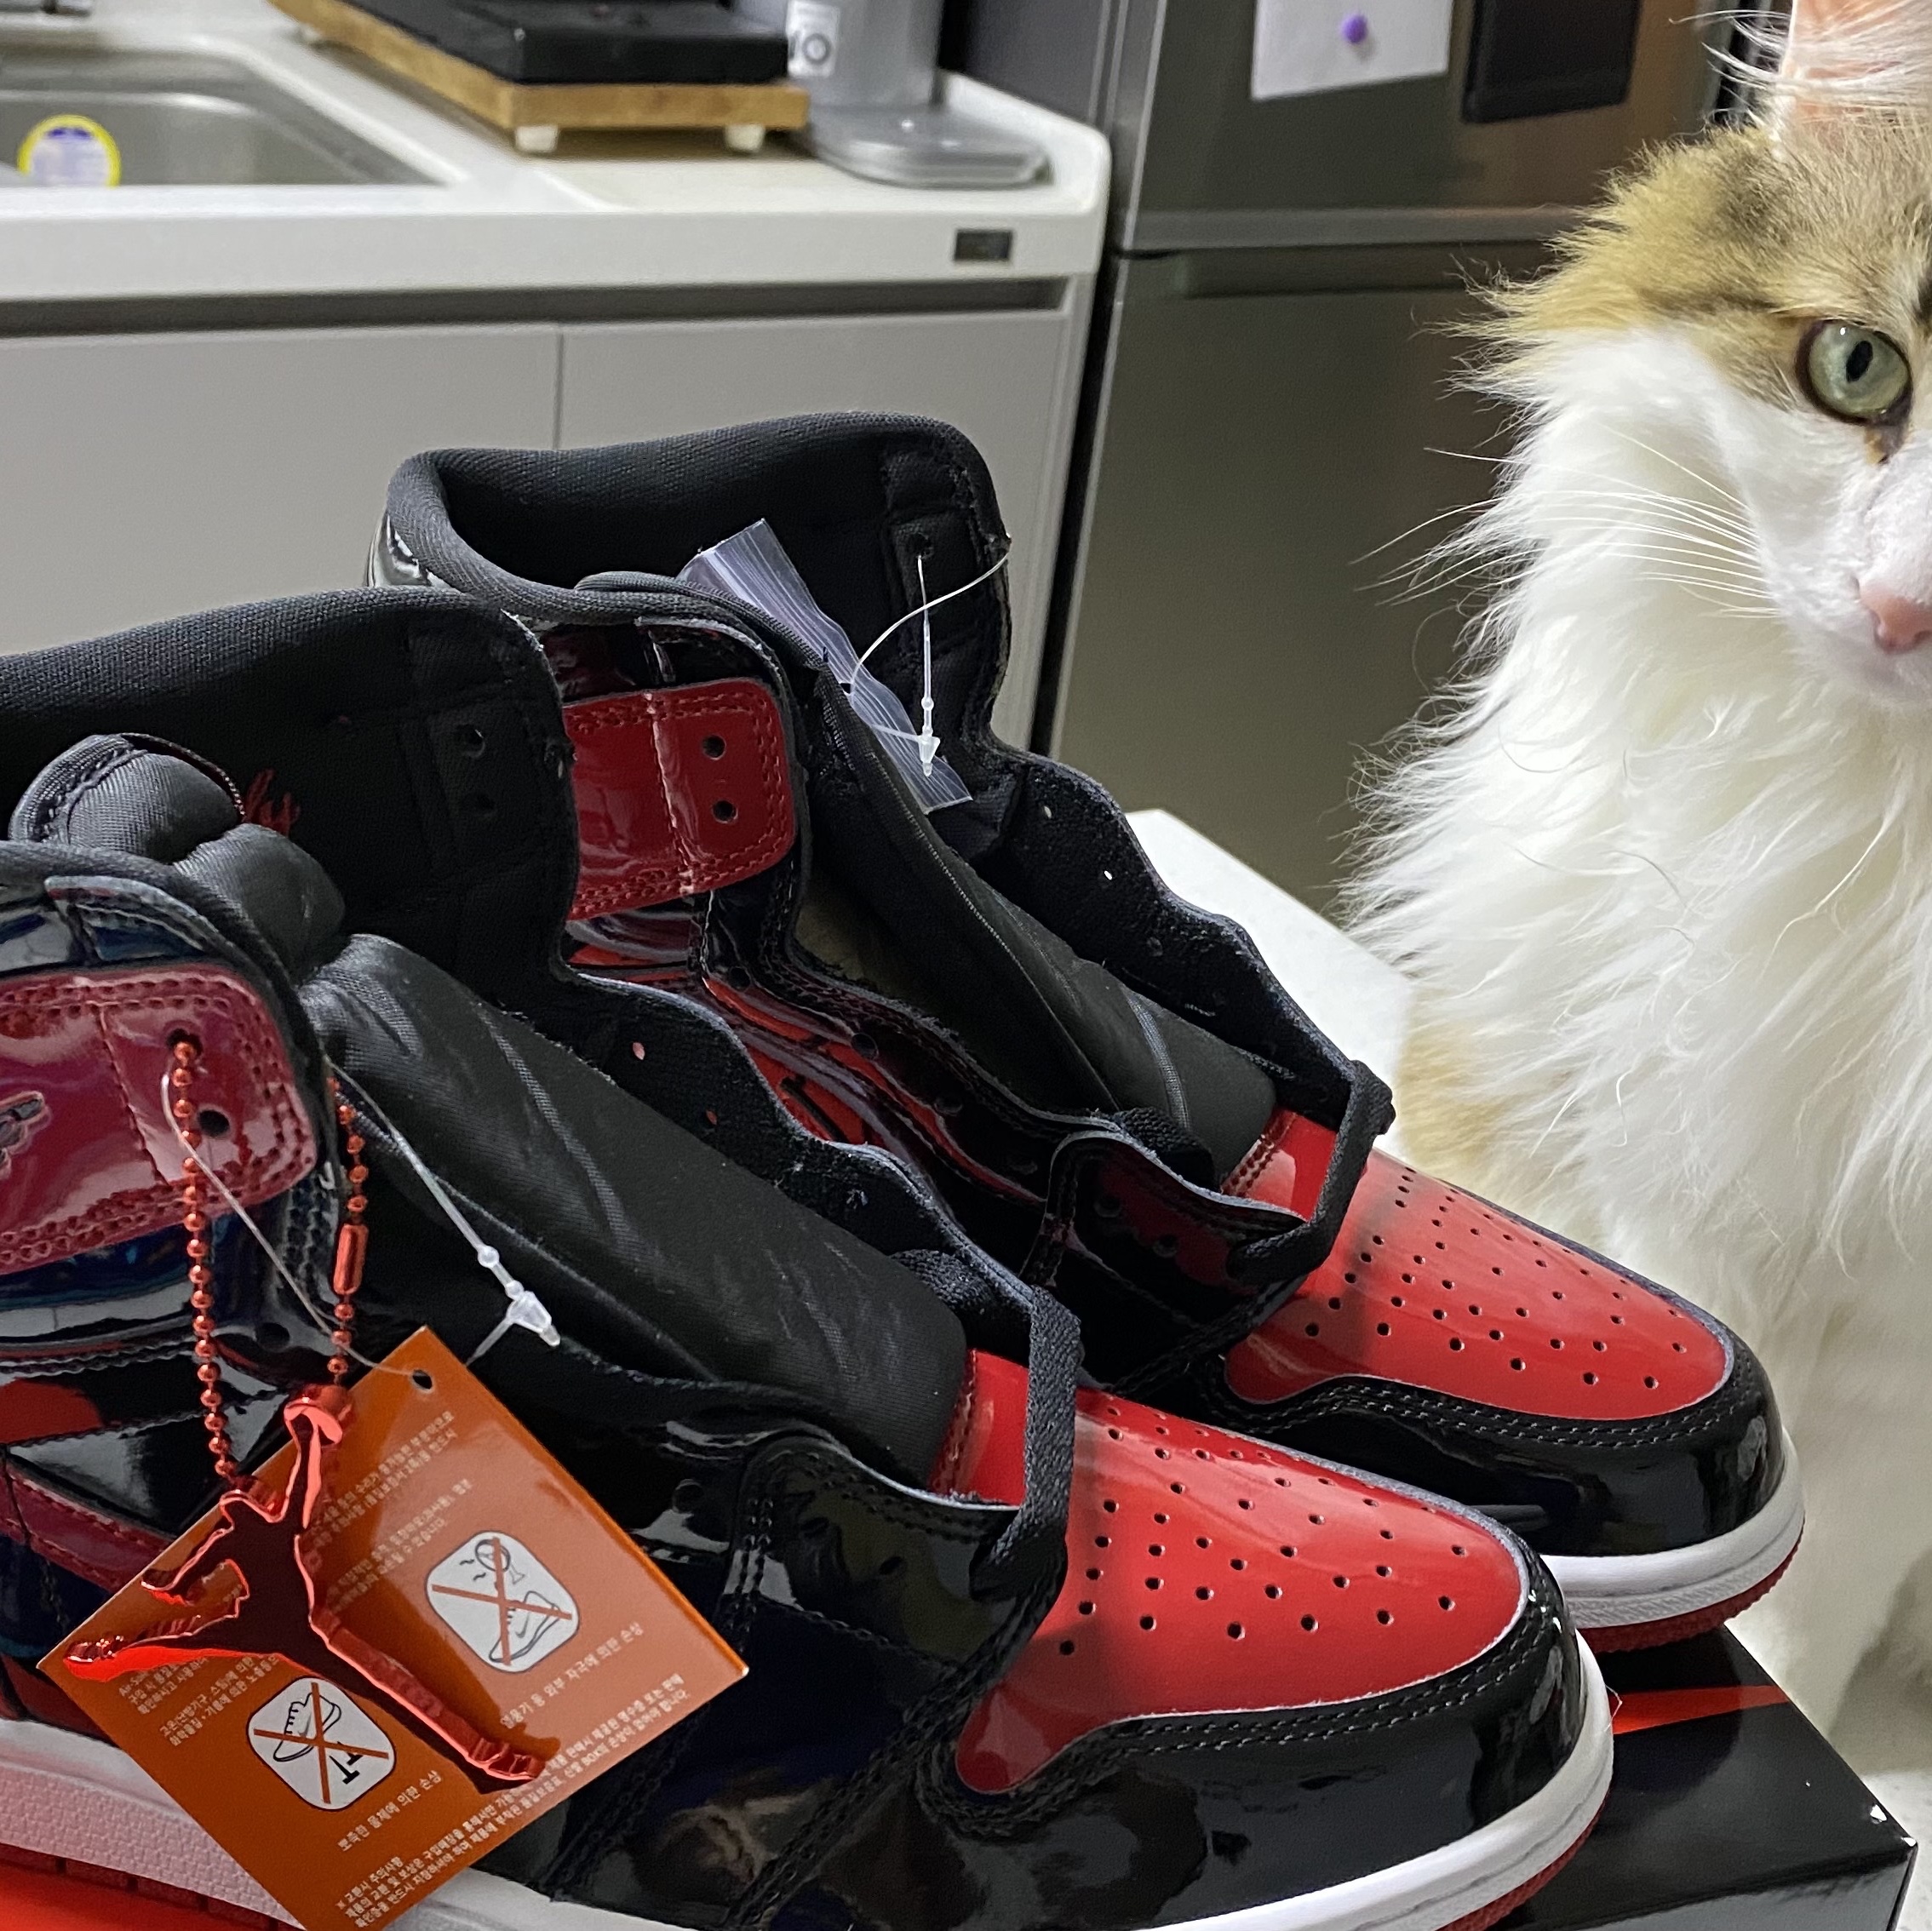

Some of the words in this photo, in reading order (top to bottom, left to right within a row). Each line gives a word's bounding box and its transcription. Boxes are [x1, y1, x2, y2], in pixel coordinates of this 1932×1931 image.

[616, 1619, 645, 1645] 손상
[365, 1800, 401, 1830] 물체에
[394, 1784, 421, 1808] 의한
[416, 1768, 443, 1791] 손상
